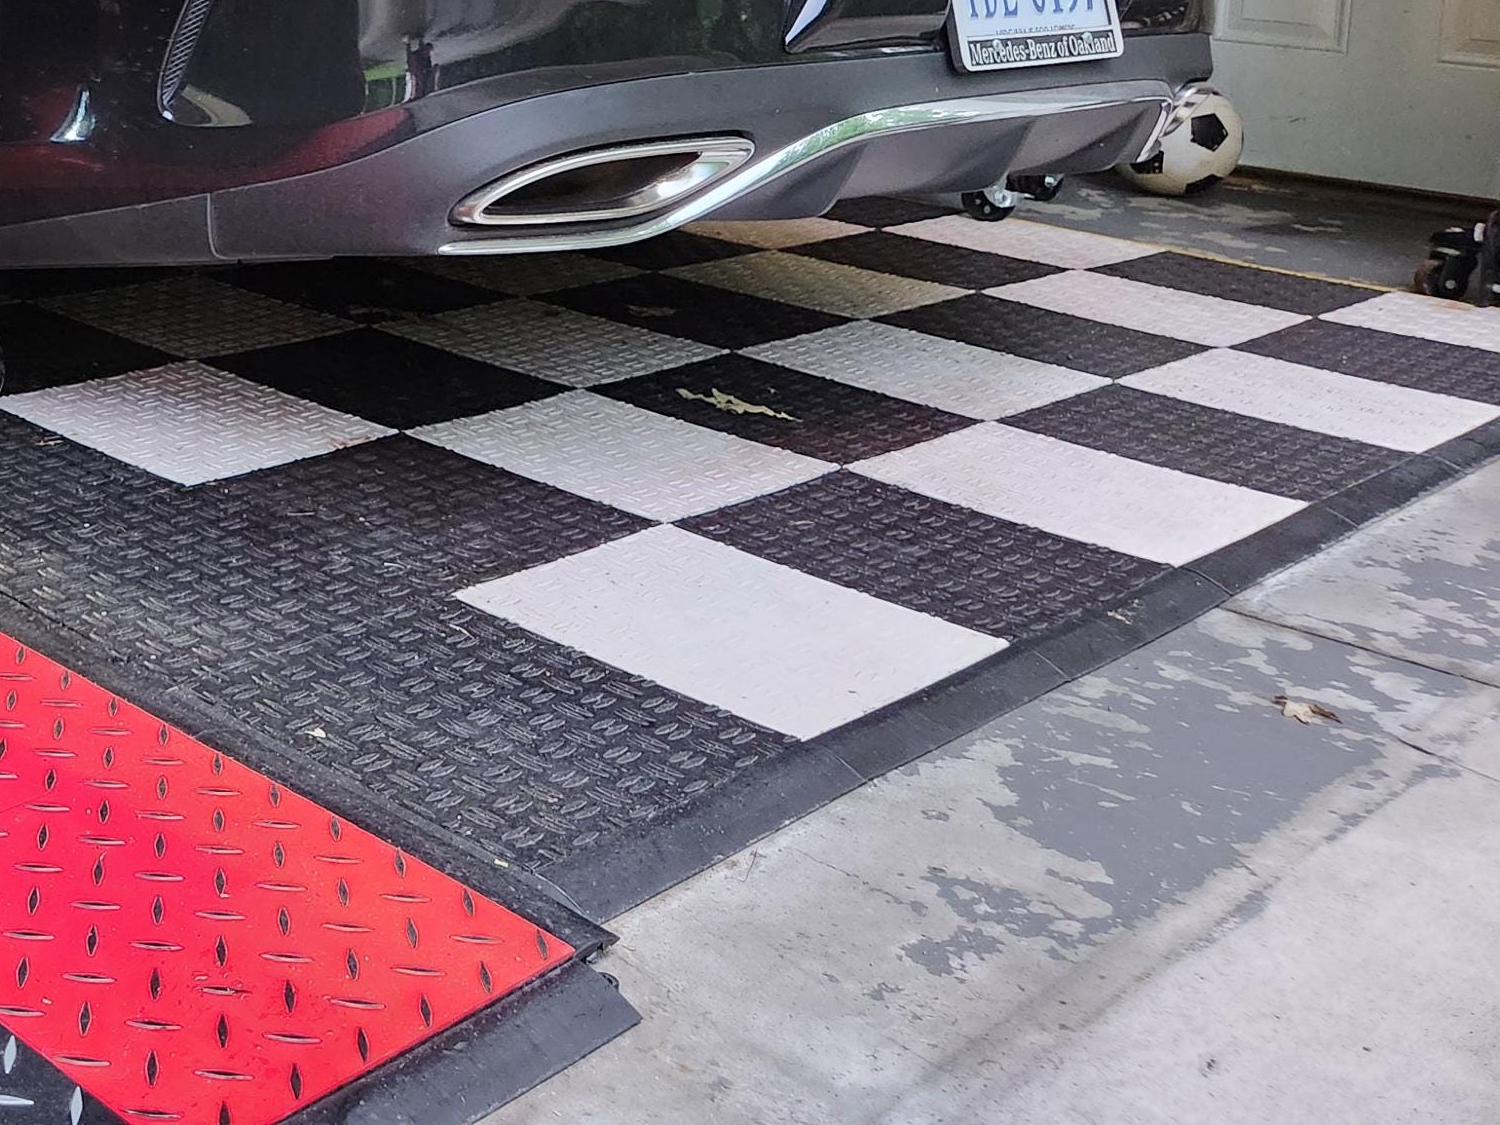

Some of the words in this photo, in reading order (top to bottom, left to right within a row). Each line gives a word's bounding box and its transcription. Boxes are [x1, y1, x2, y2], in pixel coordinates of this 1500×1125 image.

[969, 38, 1057, 66] Mercedes-Benz
[1057, 37, 1070, 57] of
[1070, 33, 1115, 56] Oakland
